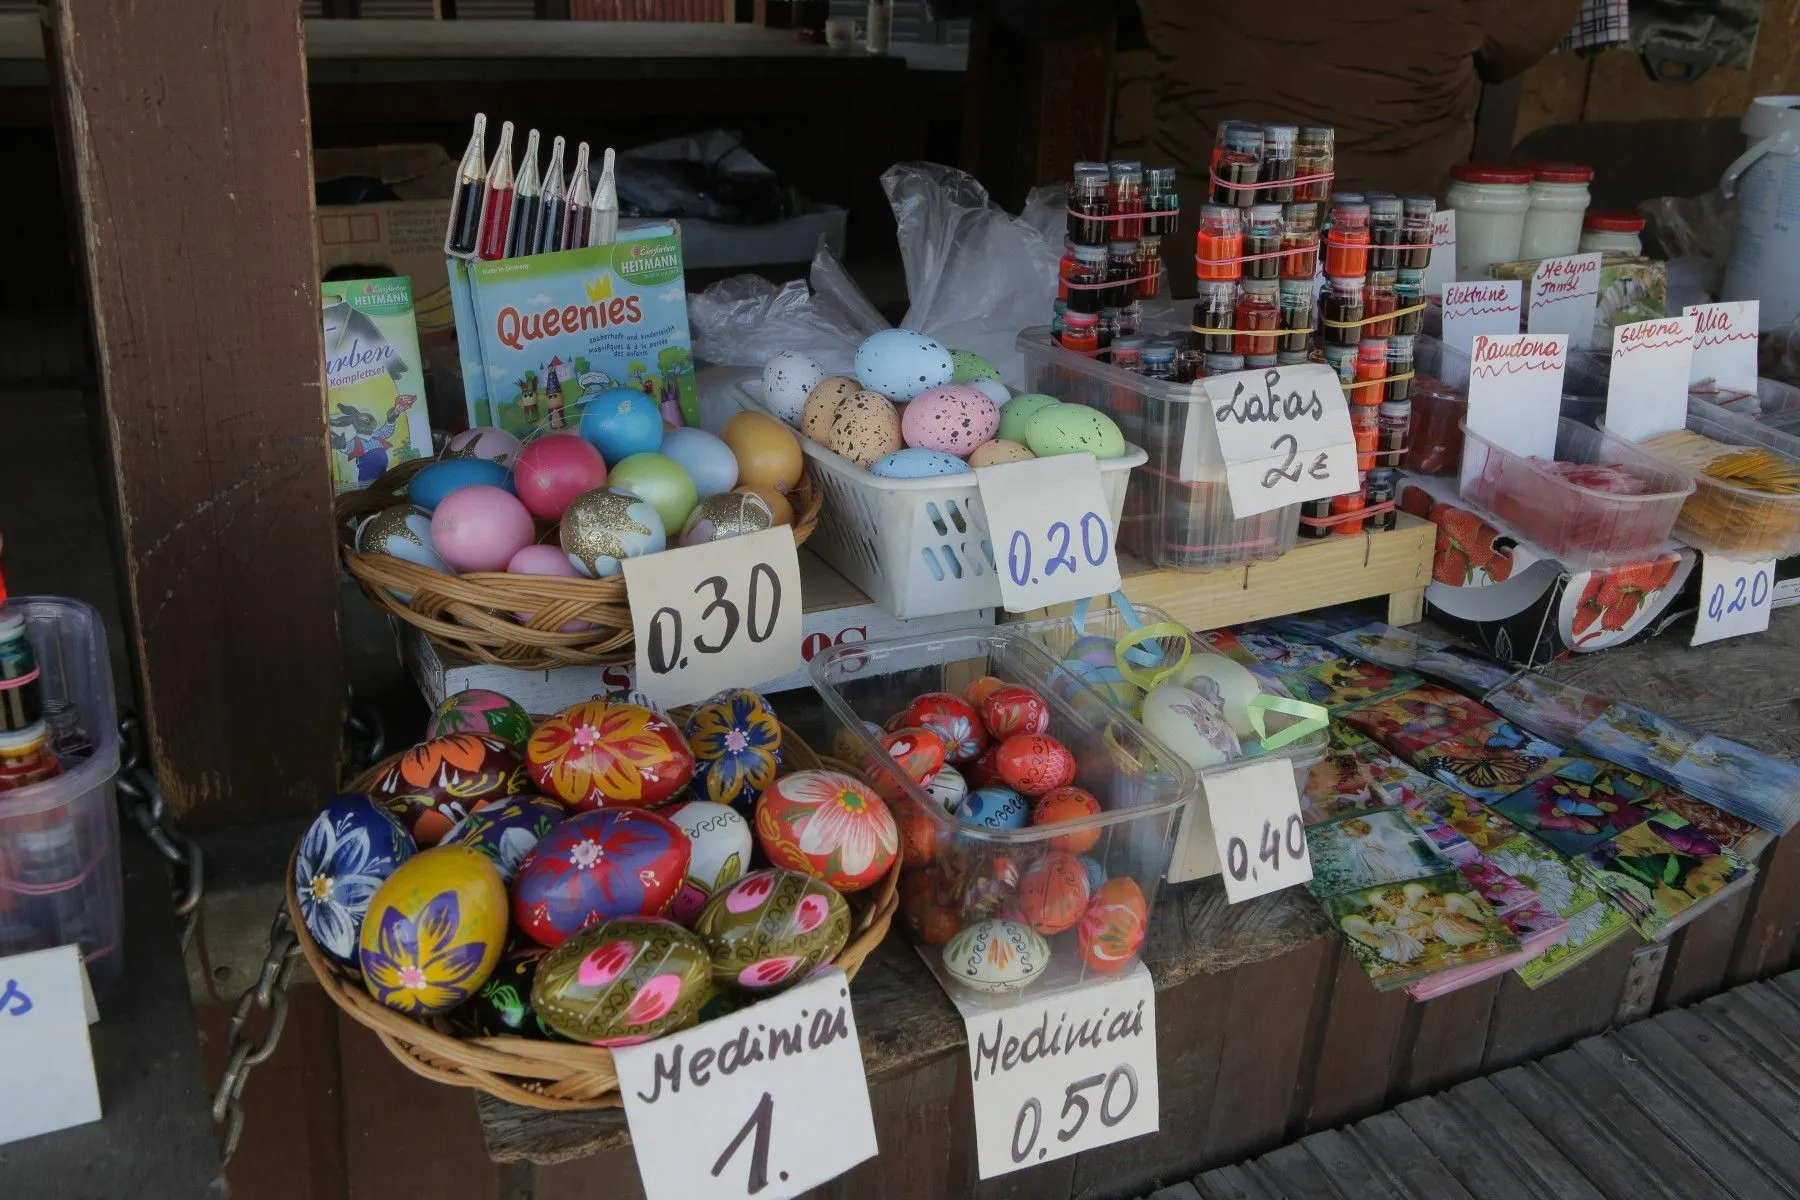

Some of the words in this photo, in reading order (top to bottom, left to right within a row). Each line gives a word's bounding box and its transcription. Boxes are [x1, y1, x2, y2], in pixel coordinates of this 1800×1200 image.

[621, 254, 678, 274] HEITMANN
[354, 292, 409, 306] HEITMANN
[496, 295, 643, 351] Queenies
[329, 366, 385, 388] Komplettset
[1474, 335, 1561, 363] Raudona
[1215, 367, 1323, 425] Lakas
[1008, 511, 1109, 587] 0.20
[647, 562, 782, 675] 0.30
[637, 987, 848, 1104] Mediniai
[973, 999, 1146, 1082] Mediniai
[711, 1091, 790, 1196] 1.
[1011, 1062, 1139, 1164] 0.50
